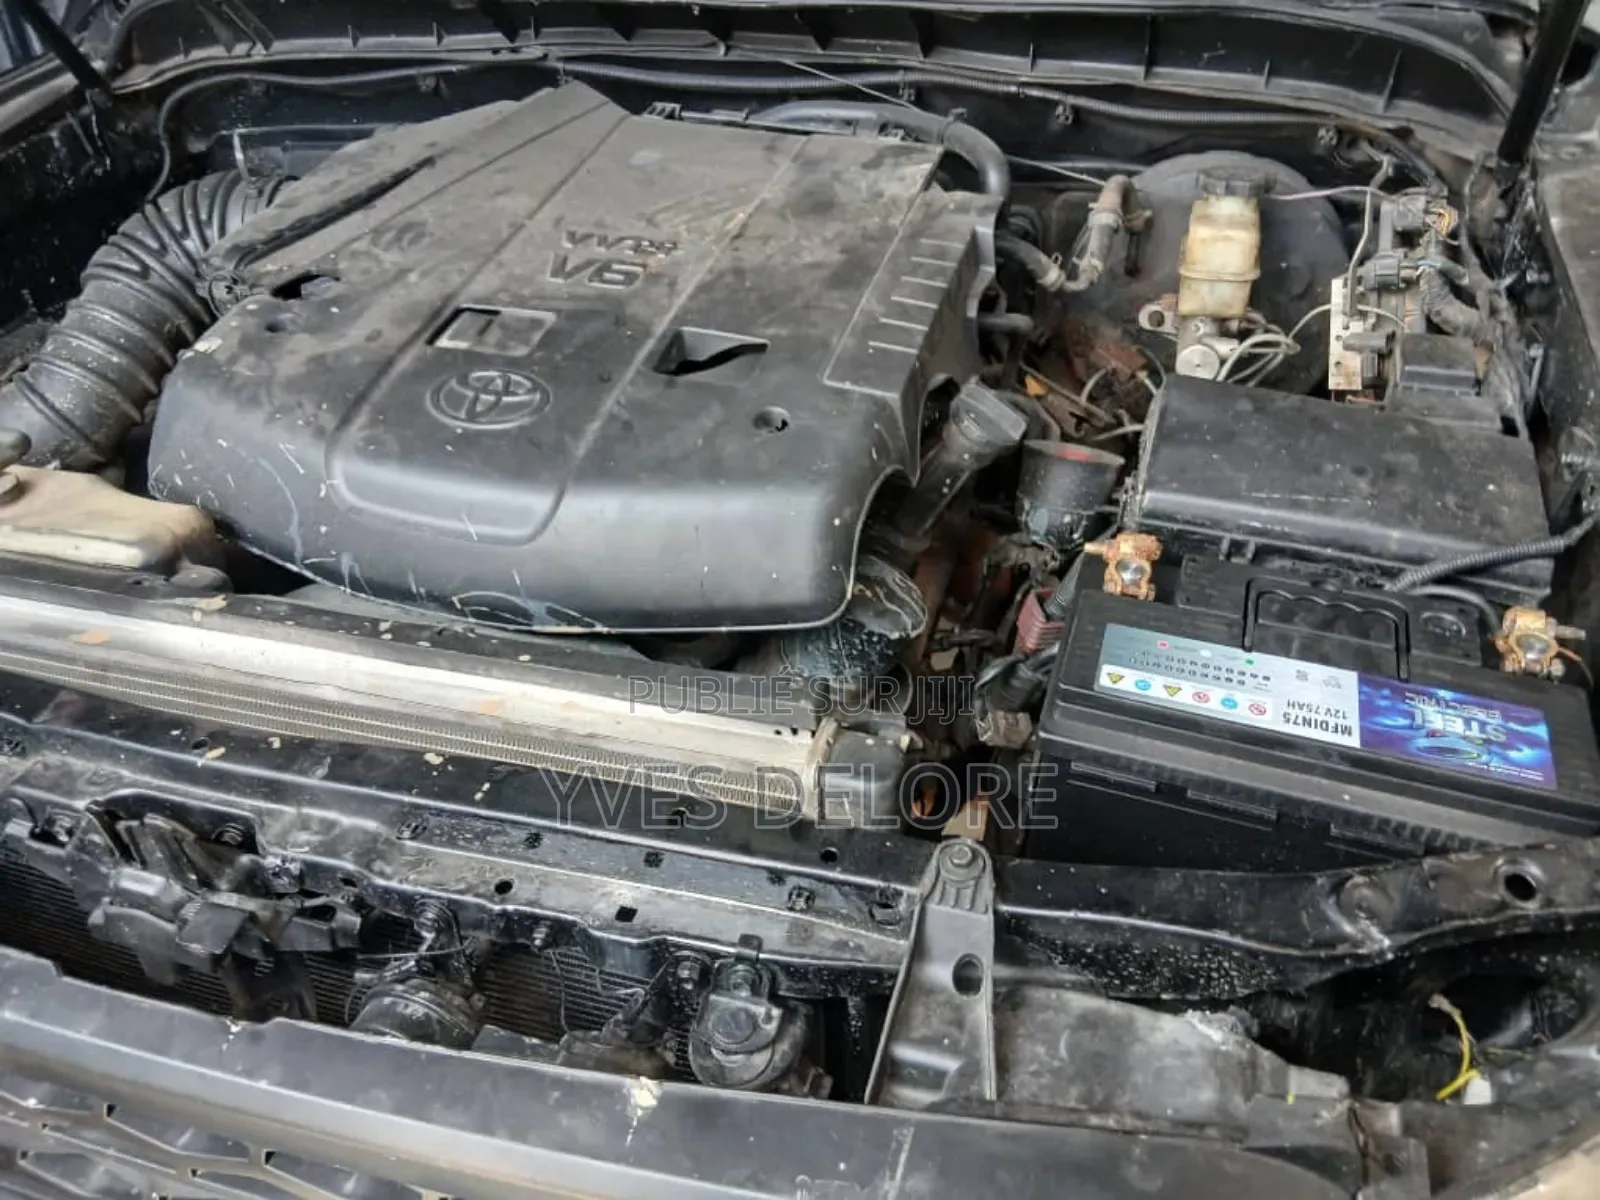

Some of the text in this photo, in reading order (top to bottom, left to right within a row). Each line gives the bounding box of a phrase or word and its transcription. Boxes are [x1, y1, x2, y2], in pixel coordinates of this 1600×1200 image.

[548, 252, 647, 290] V6
[1282, 711, 1353, 737] MFDIN75
[1287, 699, 1348, 720] 12V 75AH
[1413, 708, 1507, 742] STEEL
